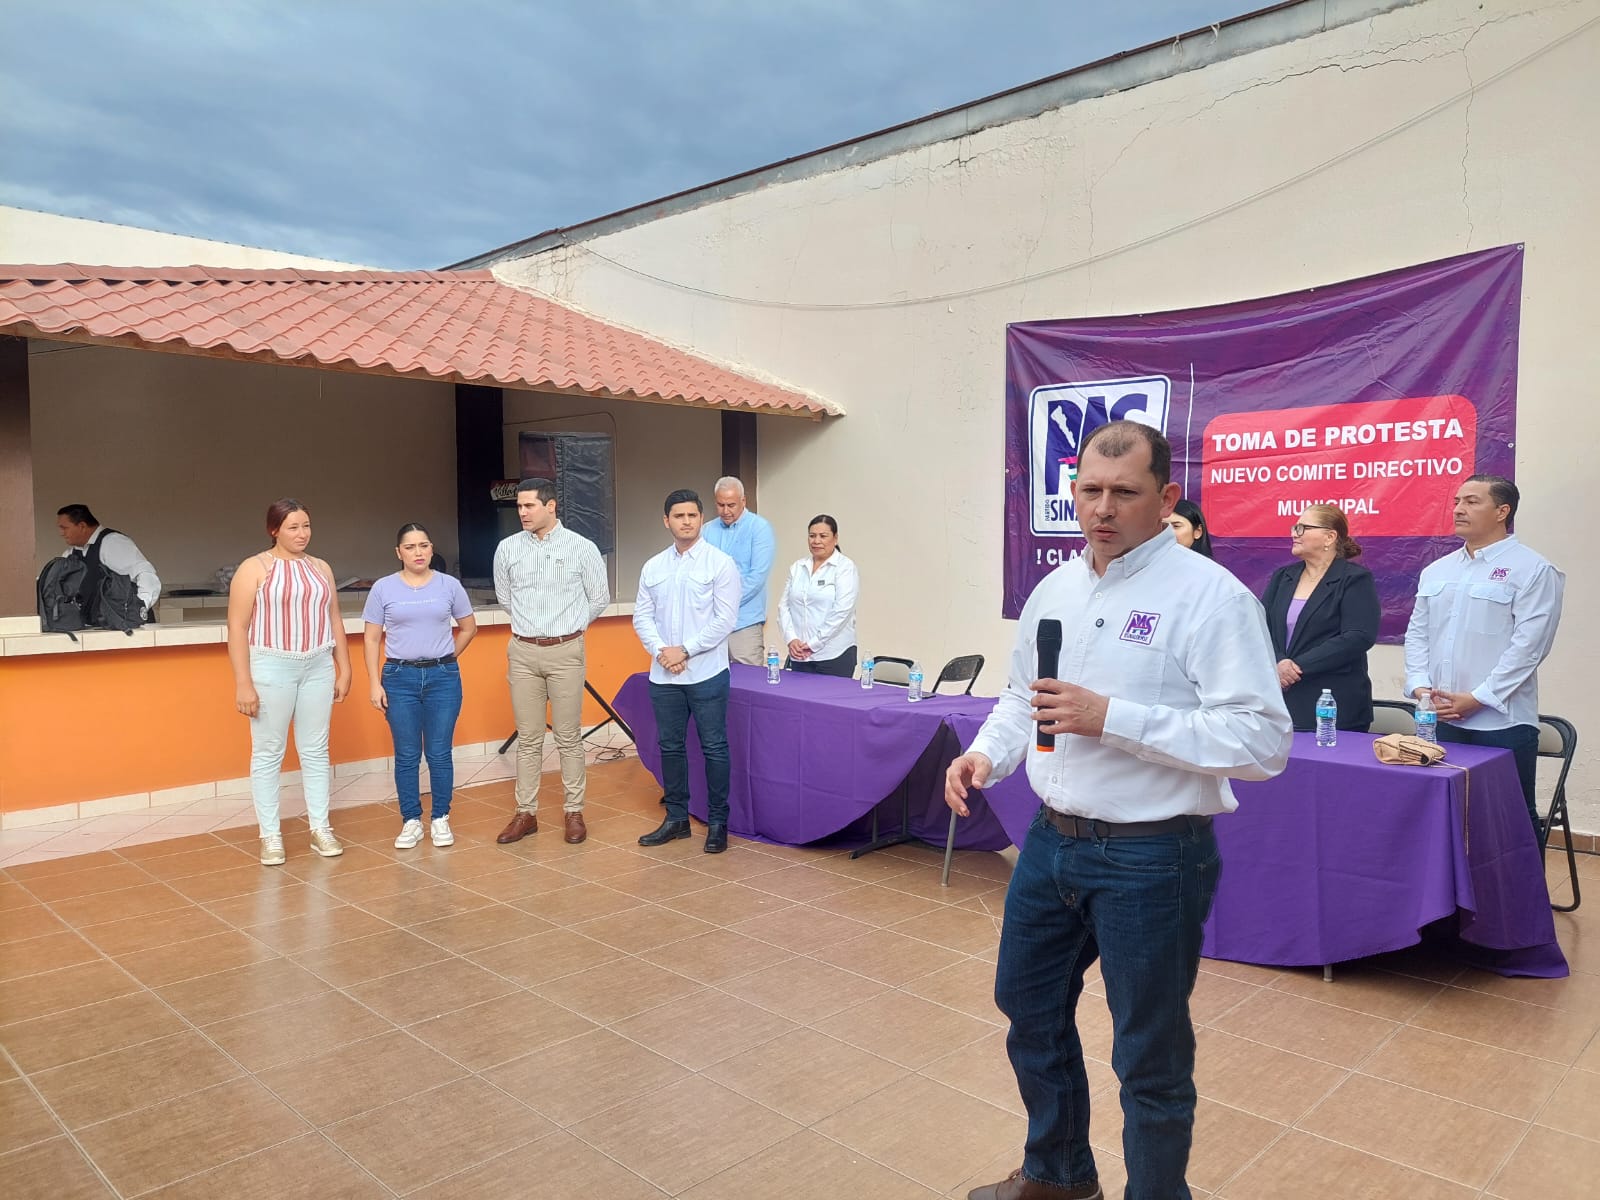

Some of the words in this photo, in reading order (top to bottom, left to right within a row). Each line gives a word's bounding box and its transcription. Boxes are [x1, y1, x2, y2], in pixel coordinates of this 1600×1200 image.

[1212, 431, 1277, 452] TOMA
[1285, 428, 1317, 448] DE
[1325, 418, 1464, 446] PROTESTA
[1210, 466, 1271, 484] NUEVO
[1276, 463, 1347, 481] COMITE
[1353, 457, 1463, 479] DIRECTIVO
[1126, 613, 1156, 635] PAS
